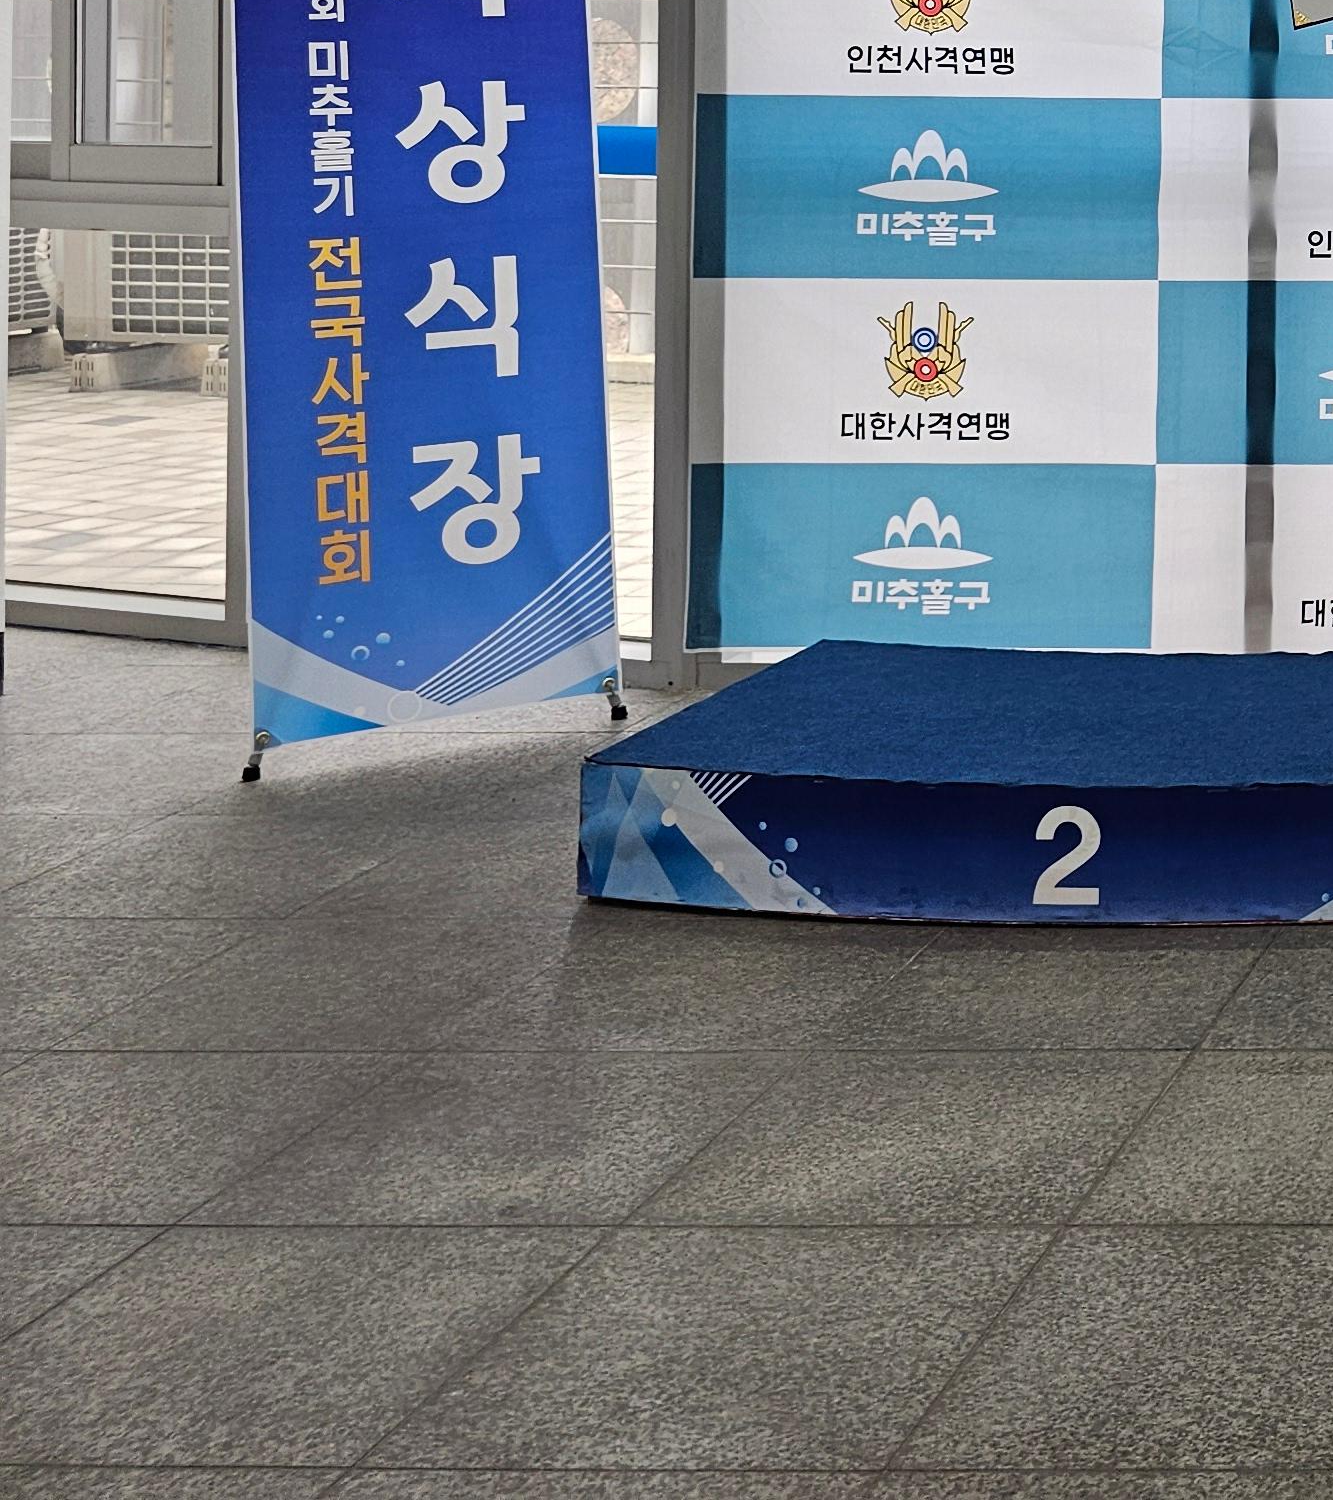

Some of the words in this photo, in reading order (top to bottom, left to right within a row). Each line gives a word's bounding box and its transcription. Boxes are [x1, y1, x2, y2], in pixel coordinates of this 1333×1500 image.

[848, 45, 1014, 75] 인천사격연맹
[309, 41, 354, 216] 미추홀기
[857, 211, 996, 246] 미추홀구
[307, 237, 373, 586] 전국사격대회
[841, 412, 1009, 440] 대한사격연맹
[852, 579, 990, 614] 미추홀구
[1033, 806, 1101, 905] 2
